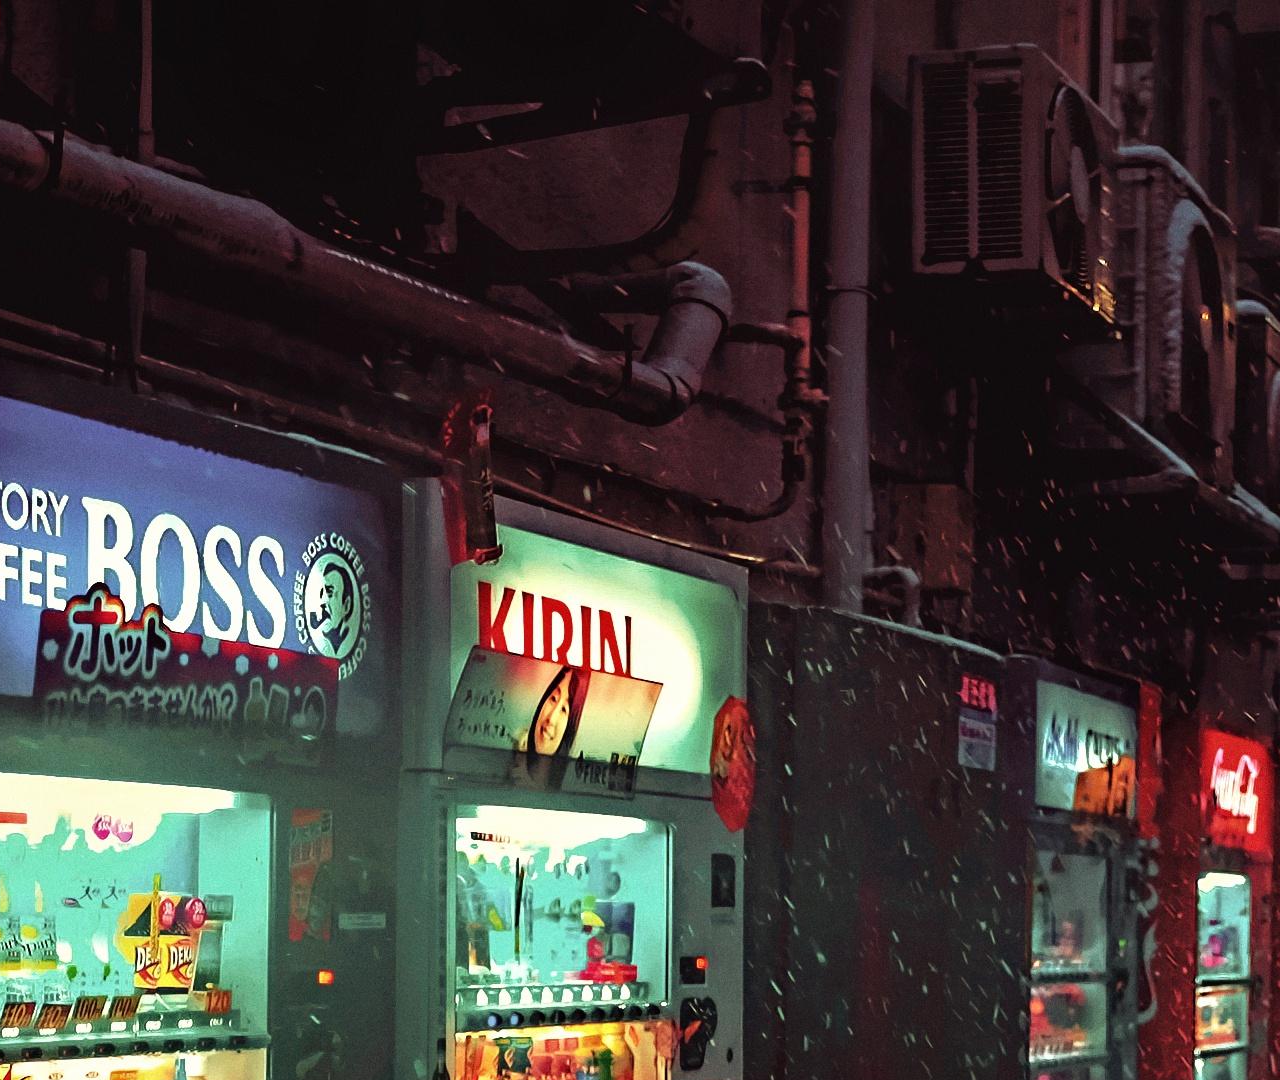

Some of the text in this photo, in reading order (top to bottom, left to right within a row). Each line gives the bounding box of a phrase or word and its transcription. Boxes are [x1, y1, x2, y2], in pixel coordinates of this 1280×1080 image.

[81, 495, 287, 650] BOSS
[301, 532, 327, 568] BOSS
[329, 532, 365, 577] COFFEE
[64, 590, 170, 681] ホット
[293, 570, 309, 645] COFFEE
[478, 581, 632, 678] KIRIN
[338, 637, 367, 681] COFFE
